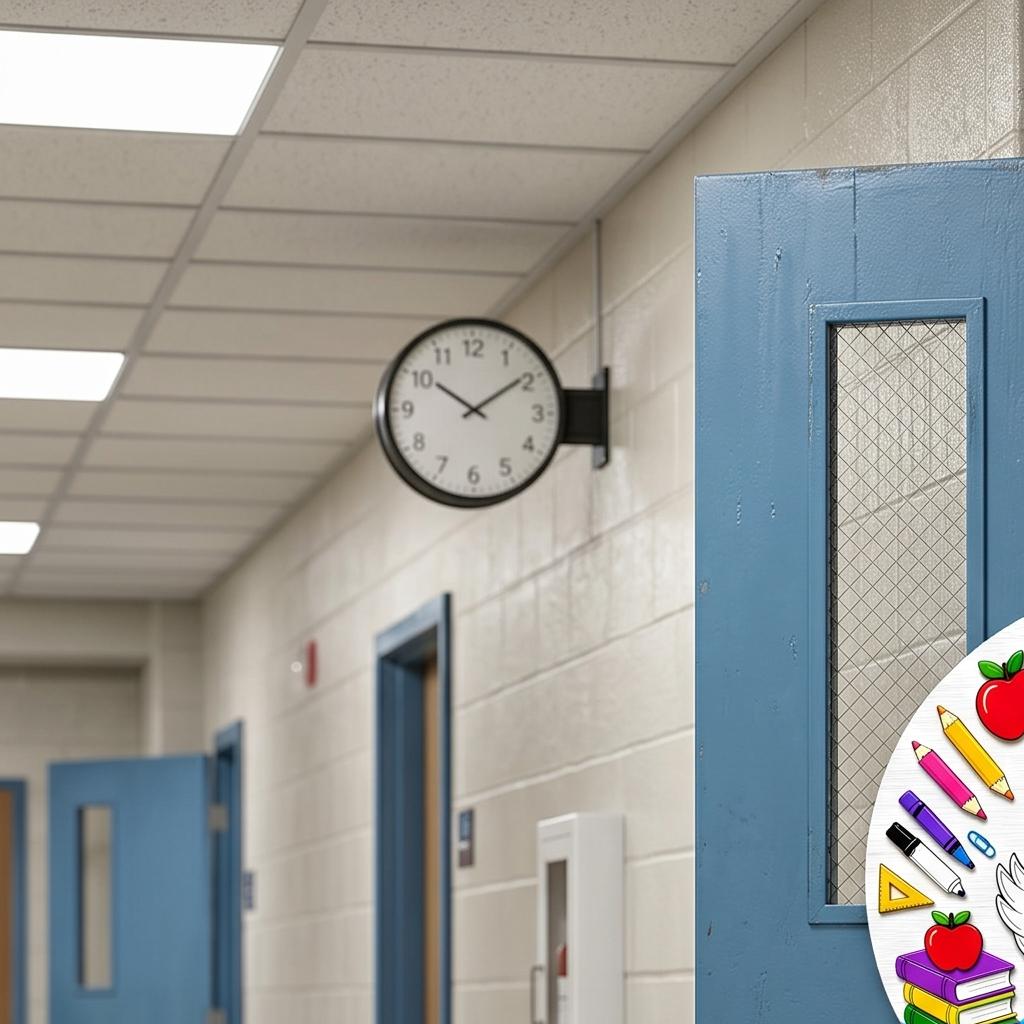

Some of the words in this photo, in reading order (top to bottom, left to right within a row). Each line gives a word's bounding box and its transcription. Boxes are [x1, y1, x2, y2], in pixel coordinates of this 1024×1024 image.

[434, 348, 450, 365] 11
[463, 339, 484, 357] 12
[502, 350, 509, 366] 1
[411, 370, 433, 389] 10
[521, 373, 535, 391] 2
[402, 401, 414, 419] 9
[532, 405, 544, 423] 3
[413, 433, 425, 451] 8
[522, 435, 534, 452] 4
[436, 456, 448, 473] 7
[500, 458, 512, 476] 5
[467, 466, 480, 484] 6
